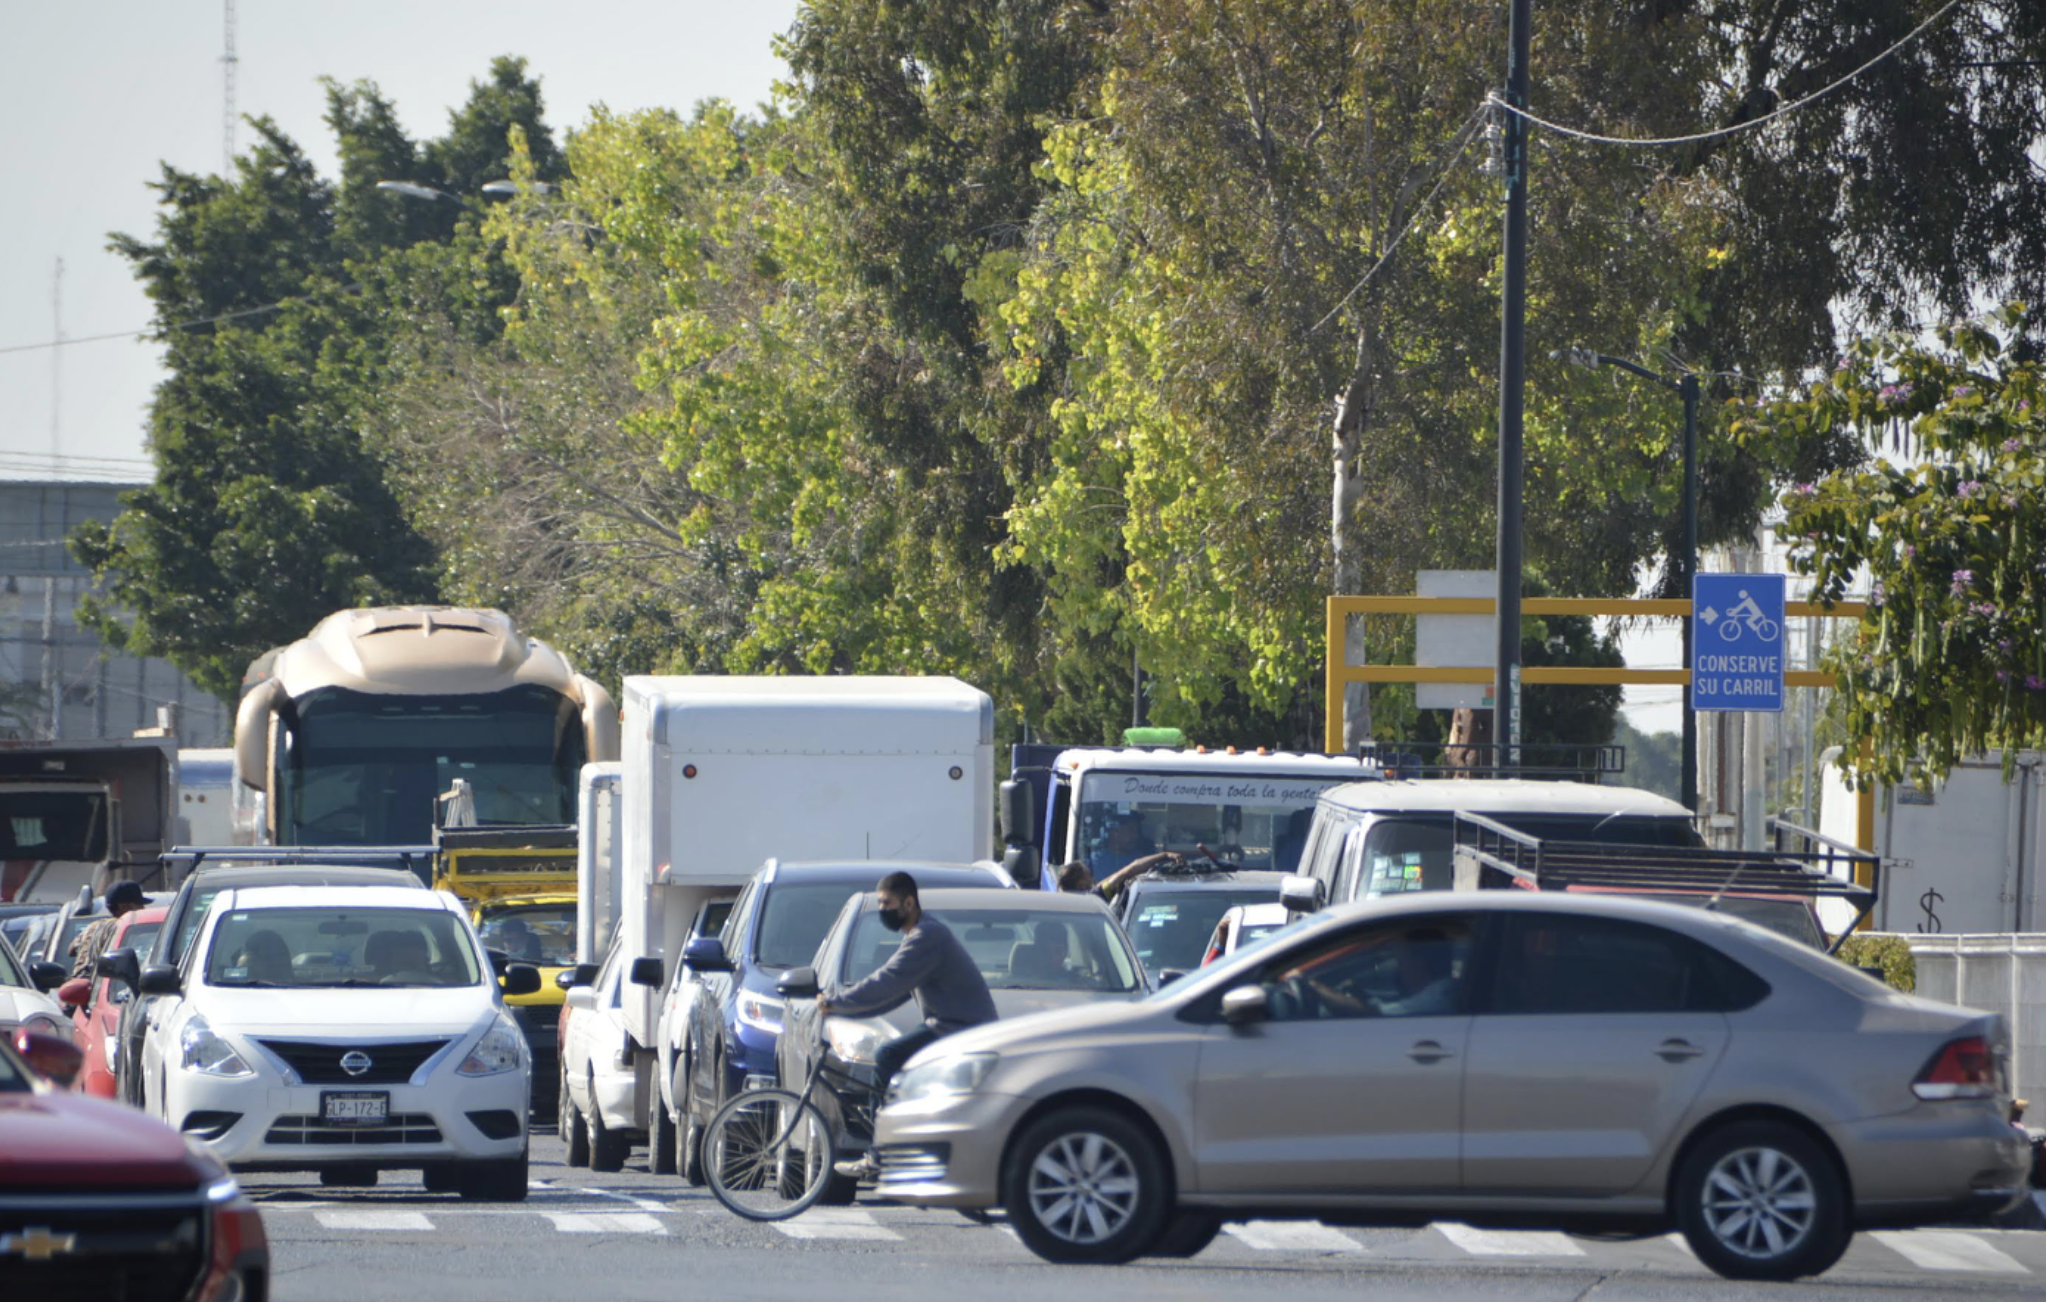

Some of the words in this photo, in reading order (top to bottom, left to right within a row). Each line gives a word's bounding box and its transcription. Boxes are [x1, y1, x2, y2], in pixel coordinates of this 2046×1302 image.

[1698, 655, 1778, 673] CONSERVE
[1697, 678, 1717, 695] SU
[1723, 678, 1778, 696] CARRIL
[1124, 777, 1168, 794] Donde
[1173, 783, 1221, 798] compra
[1227, 784, 1257, 798] toda
[1262, 784, 1276, 799] la
